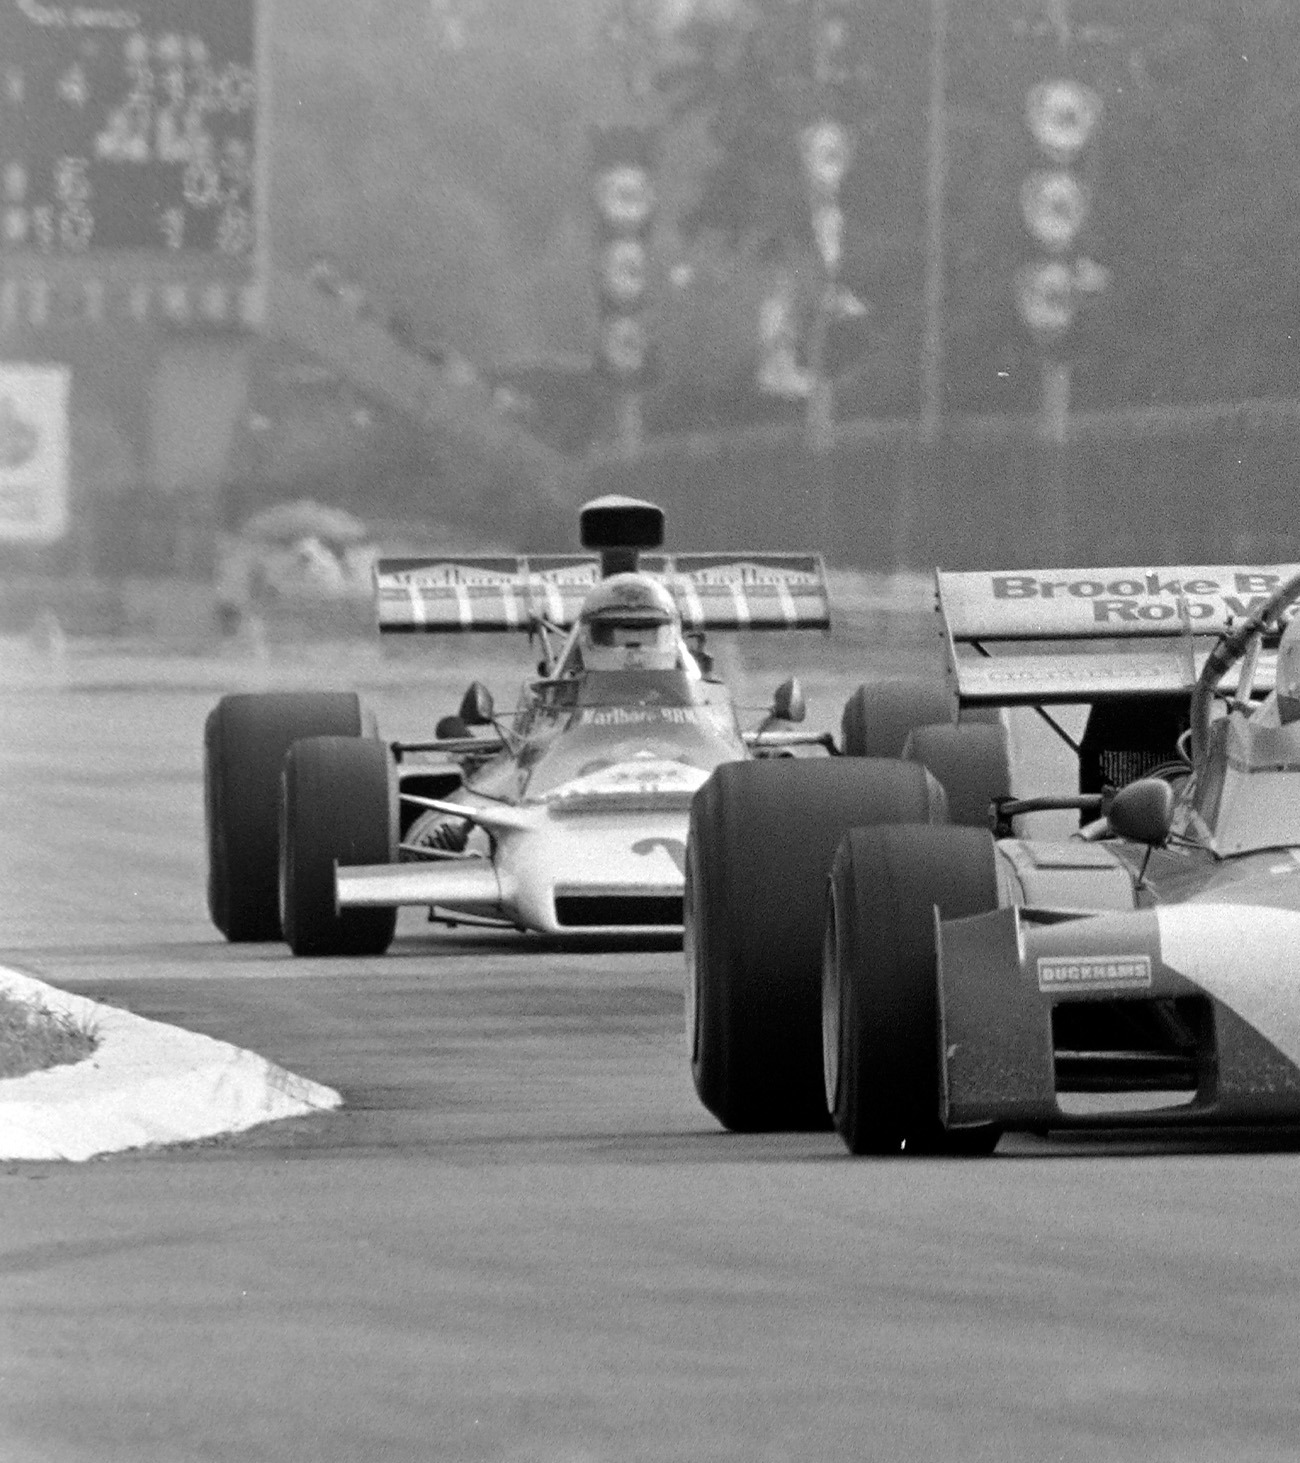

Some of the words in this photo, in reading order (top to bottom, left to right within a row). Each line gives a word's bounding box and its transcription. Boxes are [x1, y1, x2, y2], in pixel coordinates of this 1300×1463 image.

[992, 573, 1220, 599] Brooke
[1093, 599, 1214, 622] Rob
[1041, 963, 1147, 981] DUCKHAMS
